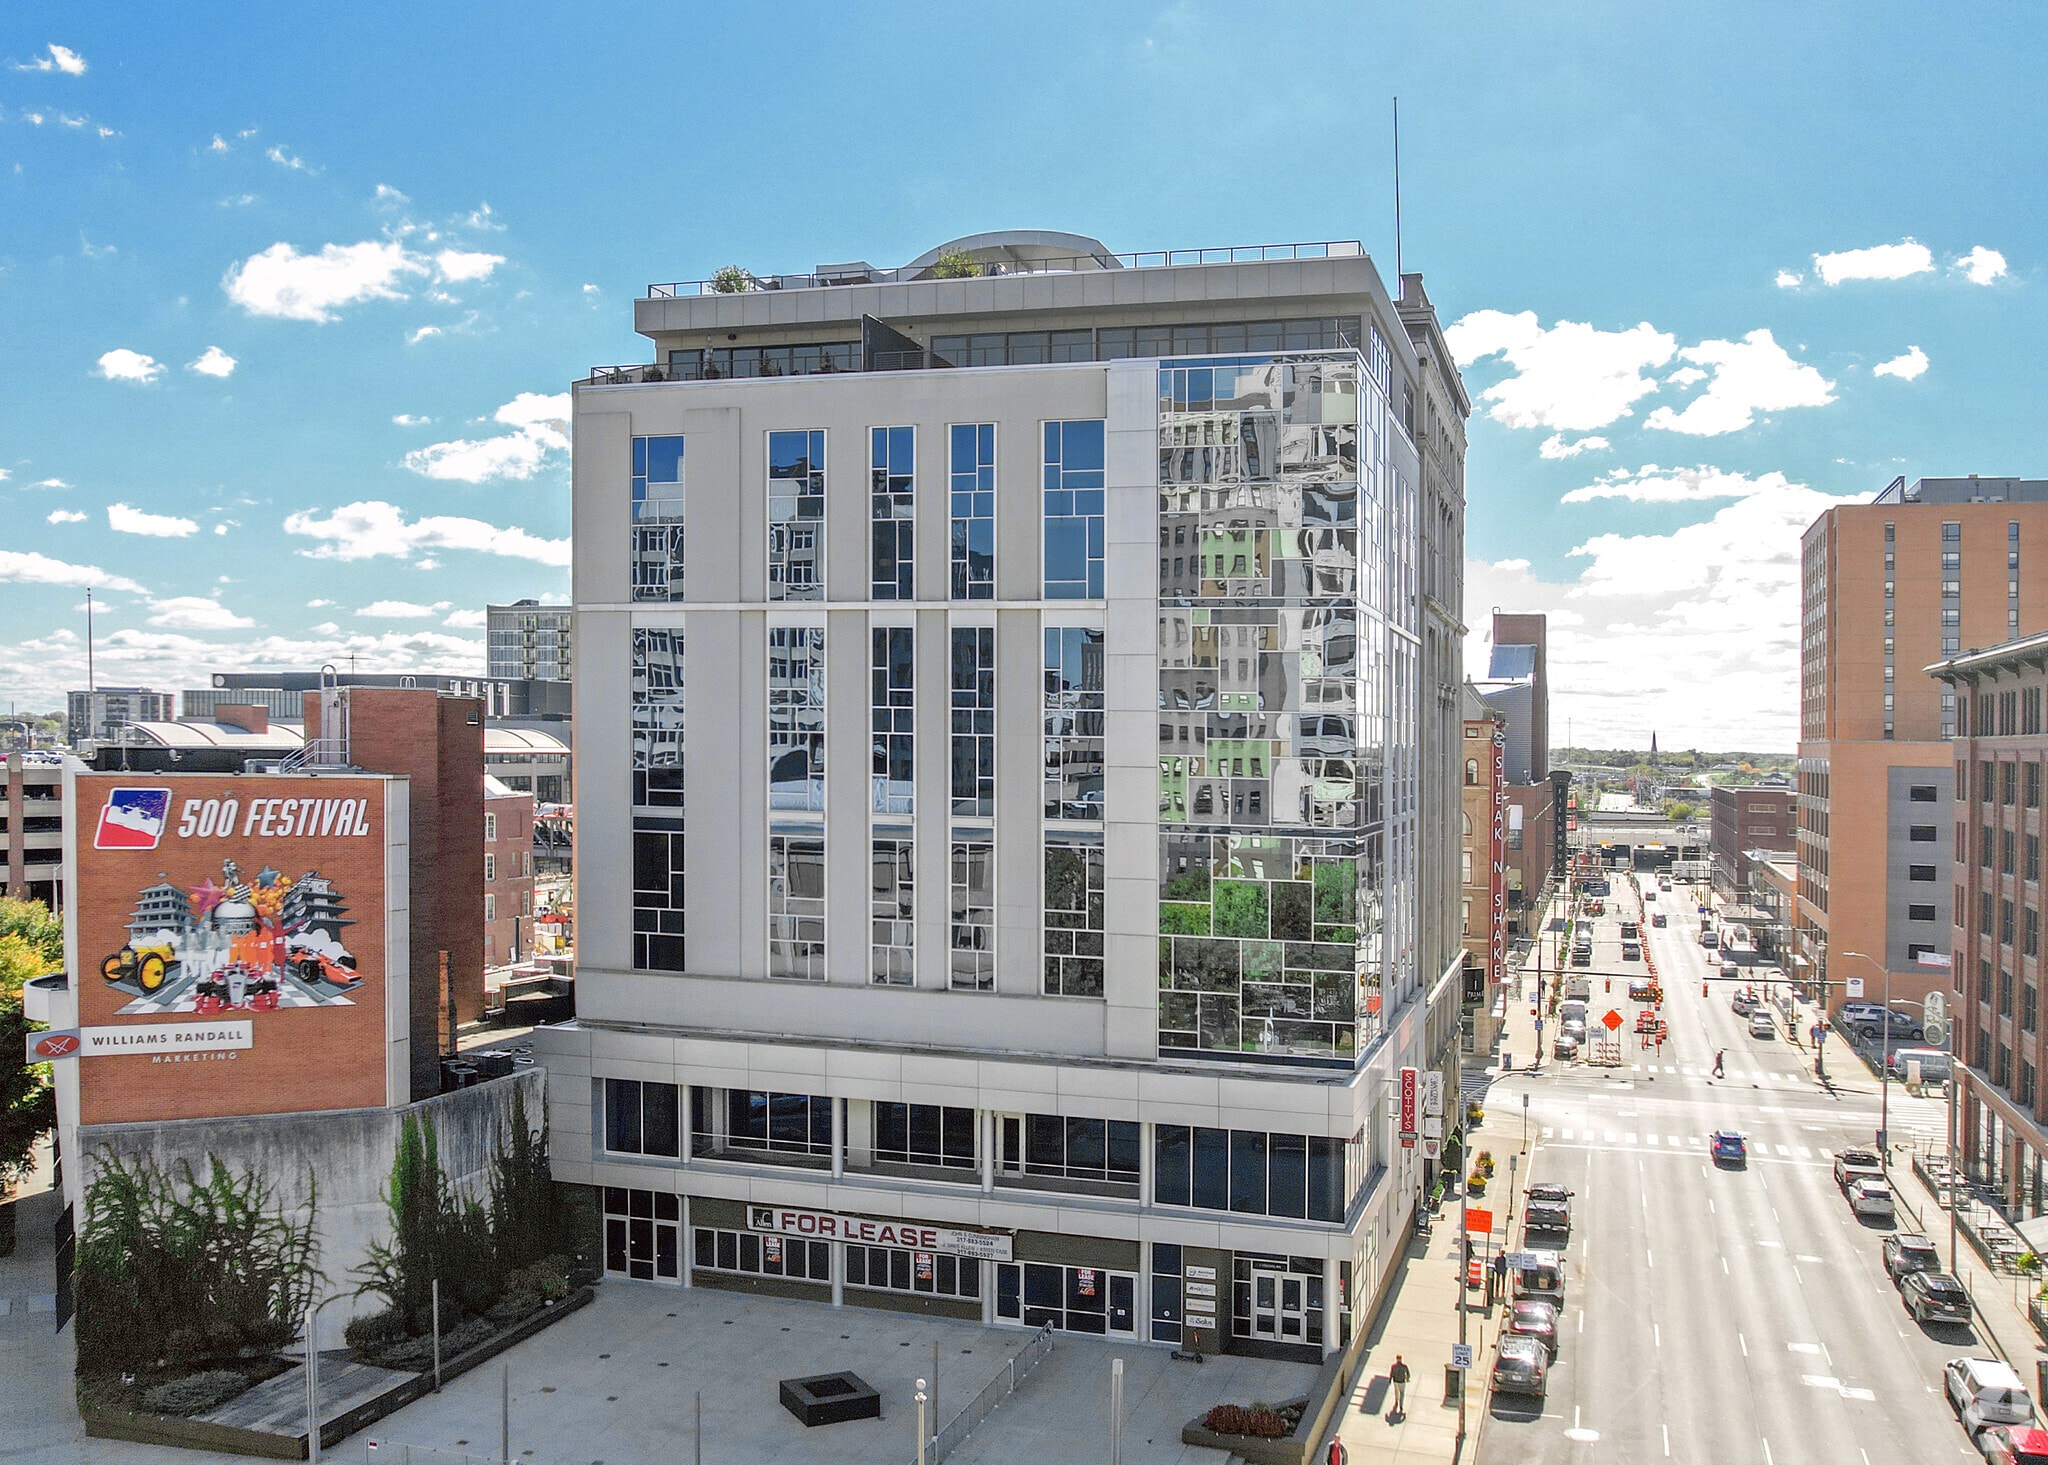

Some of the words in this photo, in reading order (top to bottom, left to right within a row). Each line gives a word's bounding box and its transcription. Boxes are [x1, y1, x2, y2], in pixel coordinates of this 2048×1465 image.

[1494, 756, 1503, 841] STEAK
[178, 798, 238, 838] 500
[244, 797, 370, 837] FESTIVAL
[1493, 859, 1503, 874] N
[1493, 893, 1503, 978] SHAKE
[92, 1034, 168, 1047] WILLIAMS
[175, 1030, 244, 1042] RANDALL
[151, 1052, 239, 1065] MARKETING
[781, 1212, 837, 1236] FOR
[844, 1220, 937, 1249] LEASE
[1454, 1356, 1470, 1366] 25
